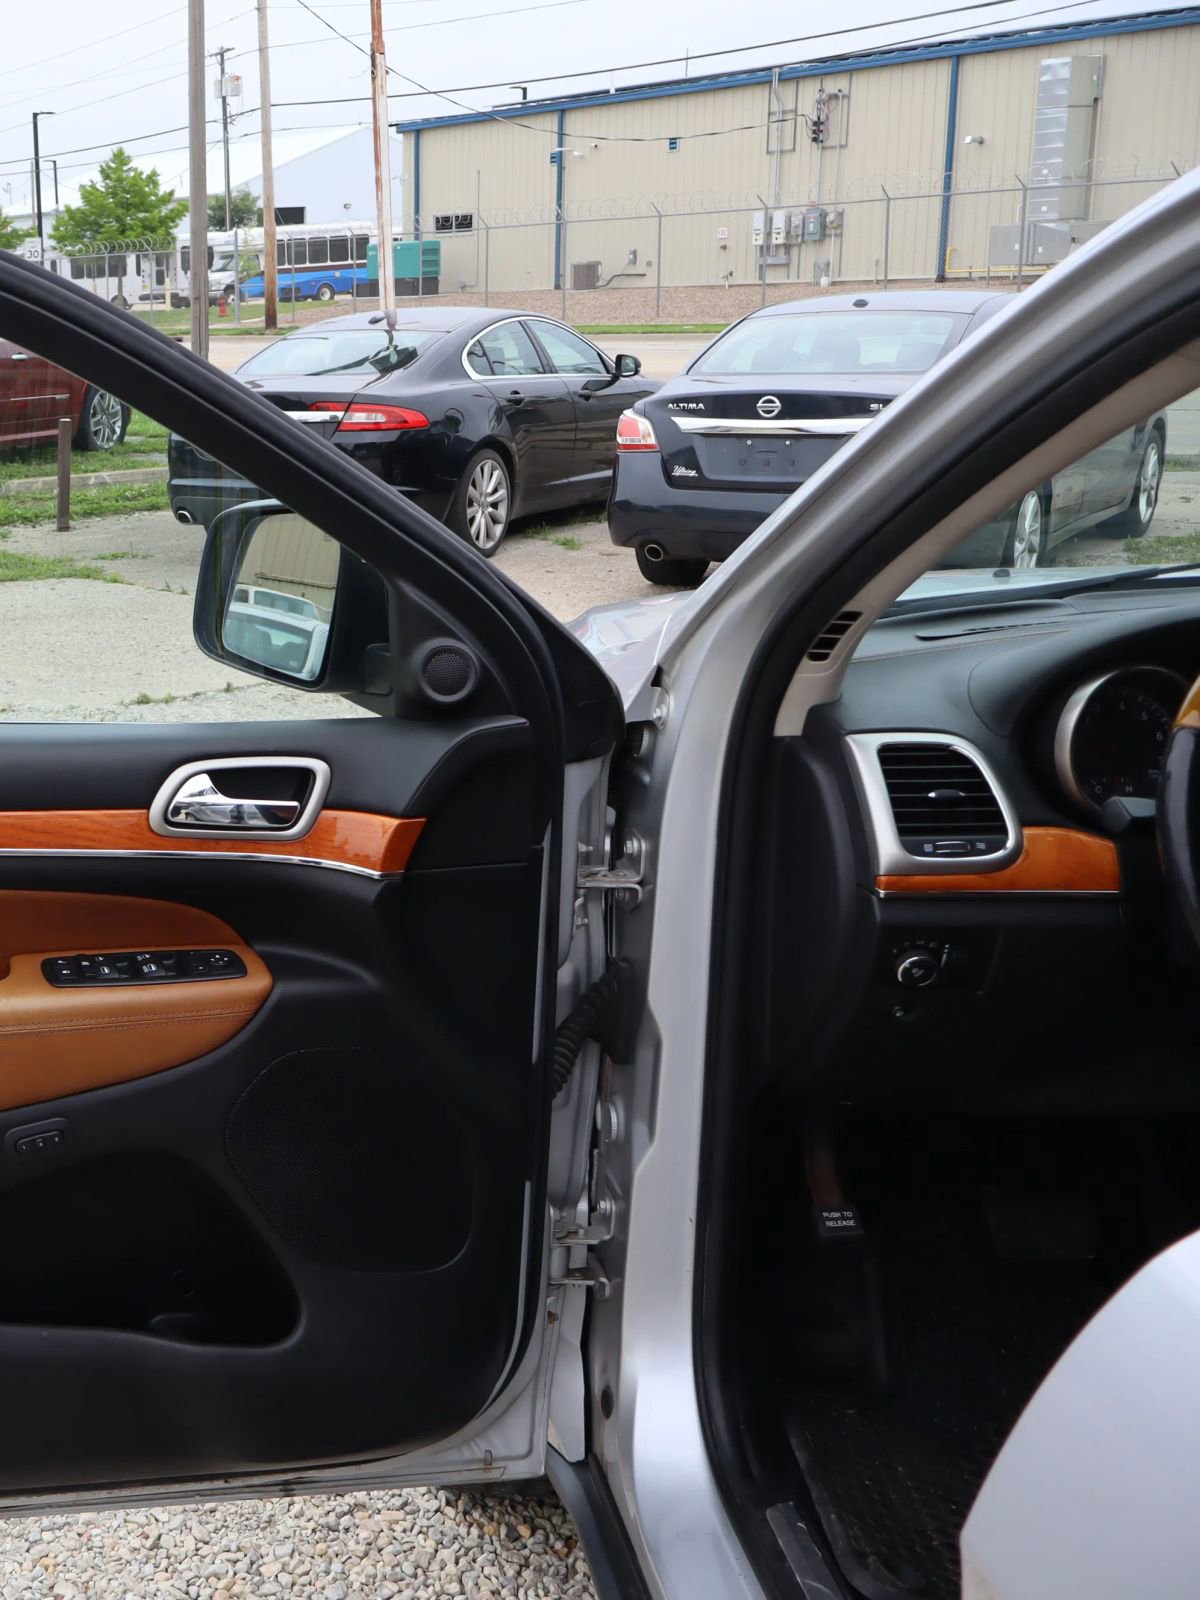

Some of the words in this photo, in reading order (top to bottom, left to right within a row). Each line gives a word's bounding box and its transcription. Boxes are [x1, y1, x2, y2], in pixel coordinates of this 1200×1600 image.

[27, 250, 40, 259] 30
[667, 402, 705, 410] ALTIMA
[1141, 712, 1148, 721] 5
[825, 1219, 856, 1227] RELEASE
